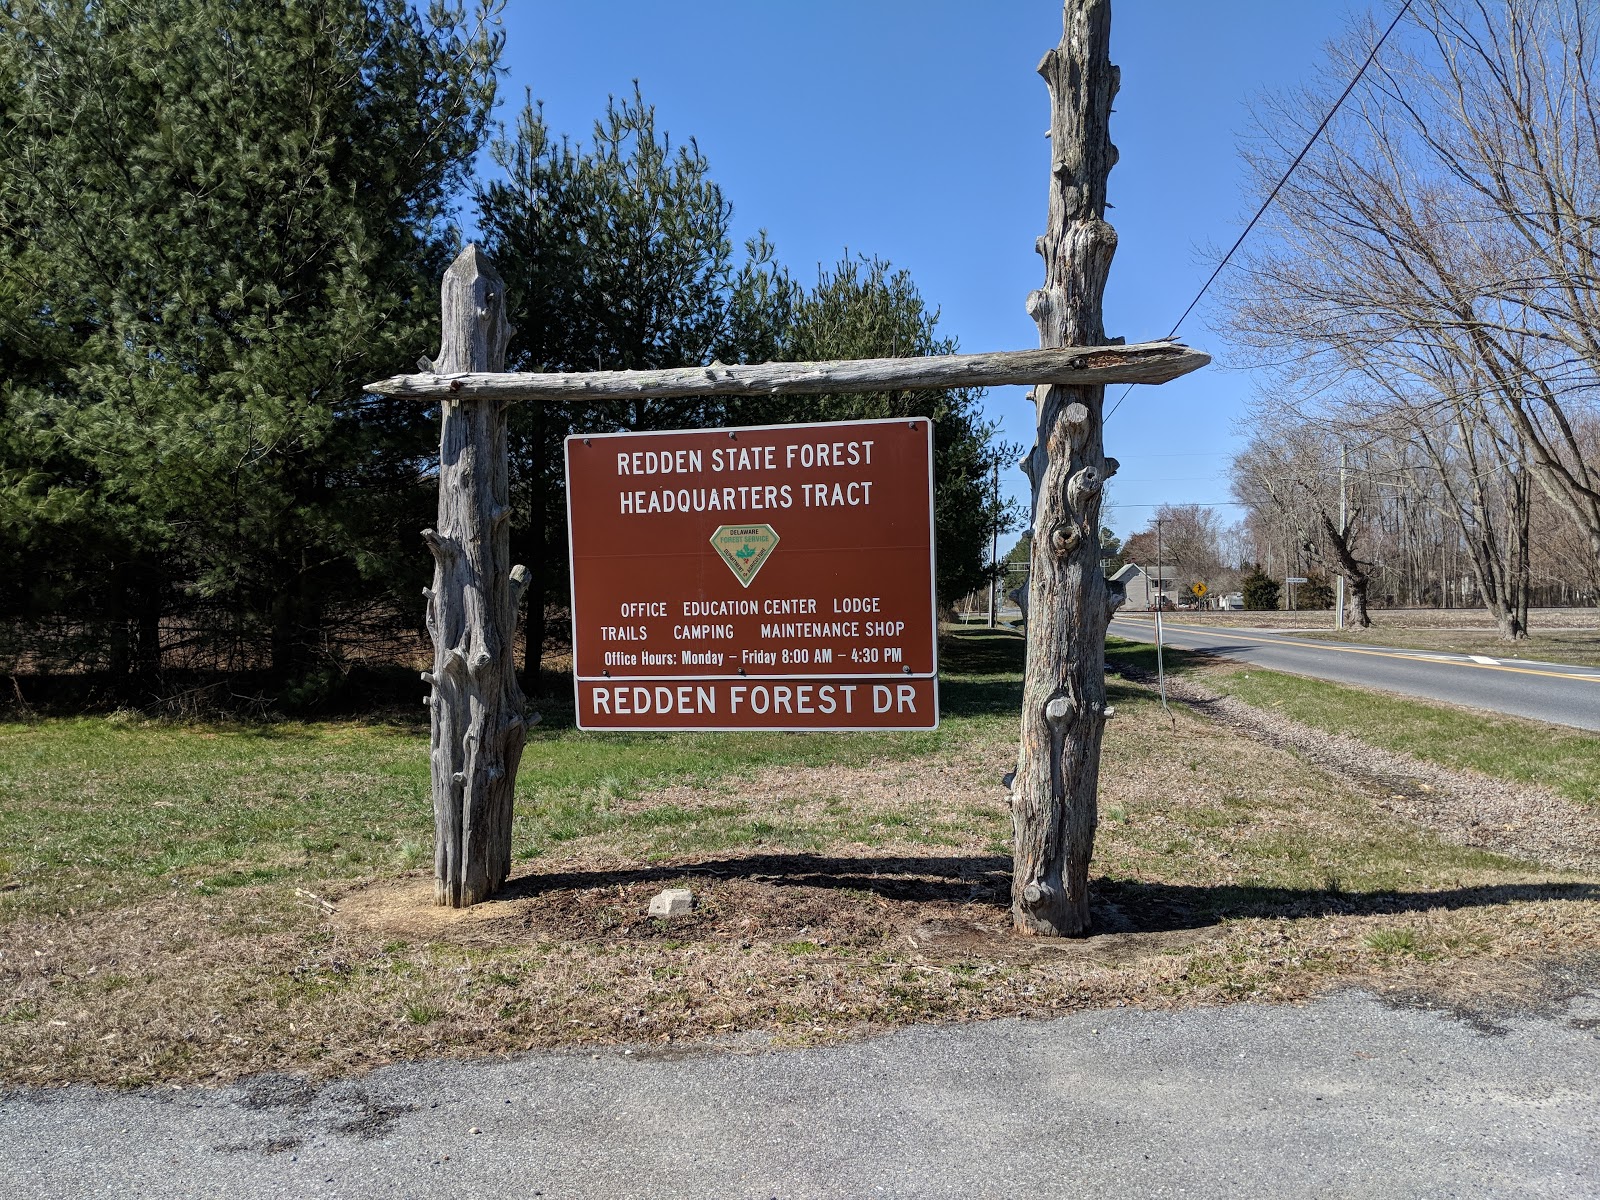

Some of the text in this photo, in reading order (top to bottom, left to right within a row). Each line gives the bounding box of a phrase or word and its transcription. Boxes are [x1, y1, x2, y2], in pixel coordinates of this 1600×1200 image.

[618, 441, 874, 475] REDDEN STATE FOREST
[620, 482, 872, 514] HEADQUARTERS TRACT
[724, 549, 744, 572] DEPARTMENT
[747, 548, 766, 573] AGRICULTURE
[621, 598, 880, 617] OFFICE EDUCATION CENTER LODGE
[601, 621, 904, 640] TRAILS CAMPING MAINTENANCE SHOP
[605, 652, 636, 665] Office
[642, 650, 676, 665] Hours:
[682, 650, 723, 666] Monday
[743, 650, 776, 665] Friday
[782, 649, 808, 663] 8:00
[814, 649, 832, 663] AM
[851, 648, 878, 662] 4:30
[884, 648, 901, 662] PM
[593, 685, 916, 714] REDDEN FOREST DR
